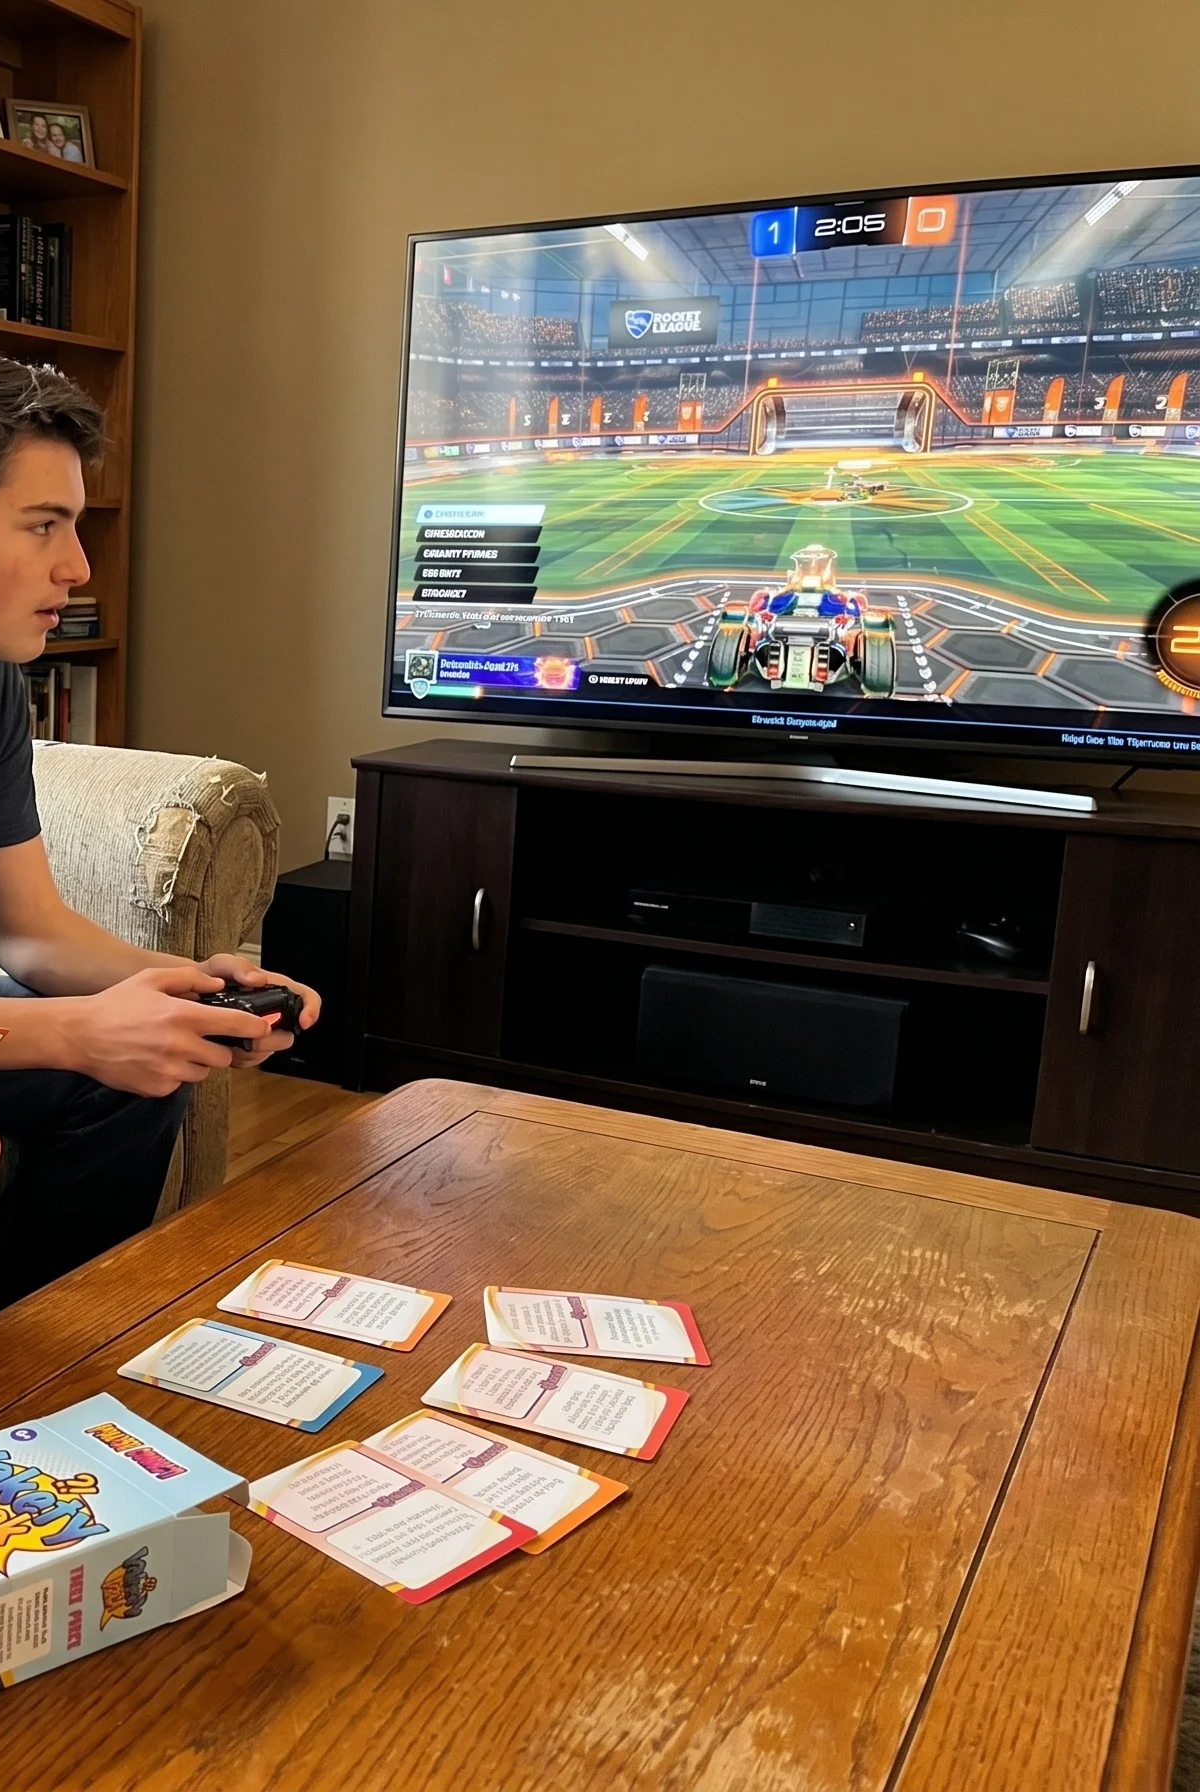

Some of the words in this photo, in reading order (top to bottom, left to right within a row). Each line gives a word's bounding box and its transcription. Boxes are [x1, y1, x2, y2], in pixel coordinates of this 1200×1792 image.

[767, 220, 780, 245] 1
[814, 213, 887, 237] 2:05
[916, 207, 947, 233] 0
